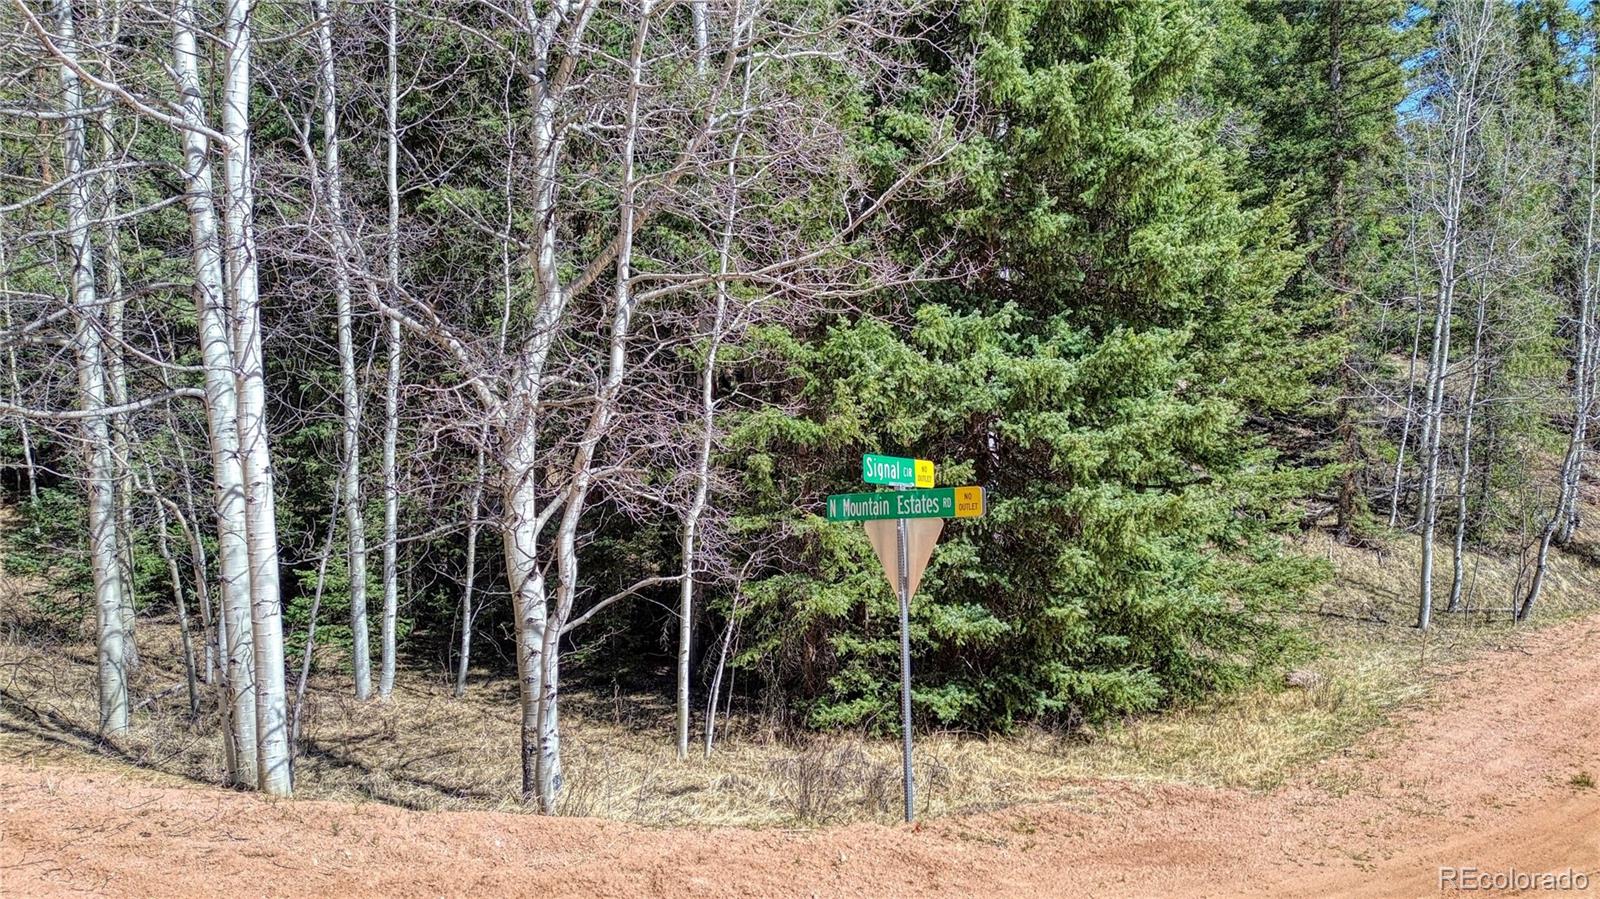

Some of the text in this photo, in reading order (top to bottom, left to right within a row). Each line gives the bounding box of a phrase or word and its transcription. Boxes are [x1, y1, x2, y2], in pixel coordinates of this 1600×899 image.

[866, 457, 913, 480] Signal CIR
[918, 474, 932, 483] OUTLET
[964, 492, 972, 500] NO
[829, 495, 952, 518] N Mountain Estates RD
[958, 503, 978, 511] OUTLET
